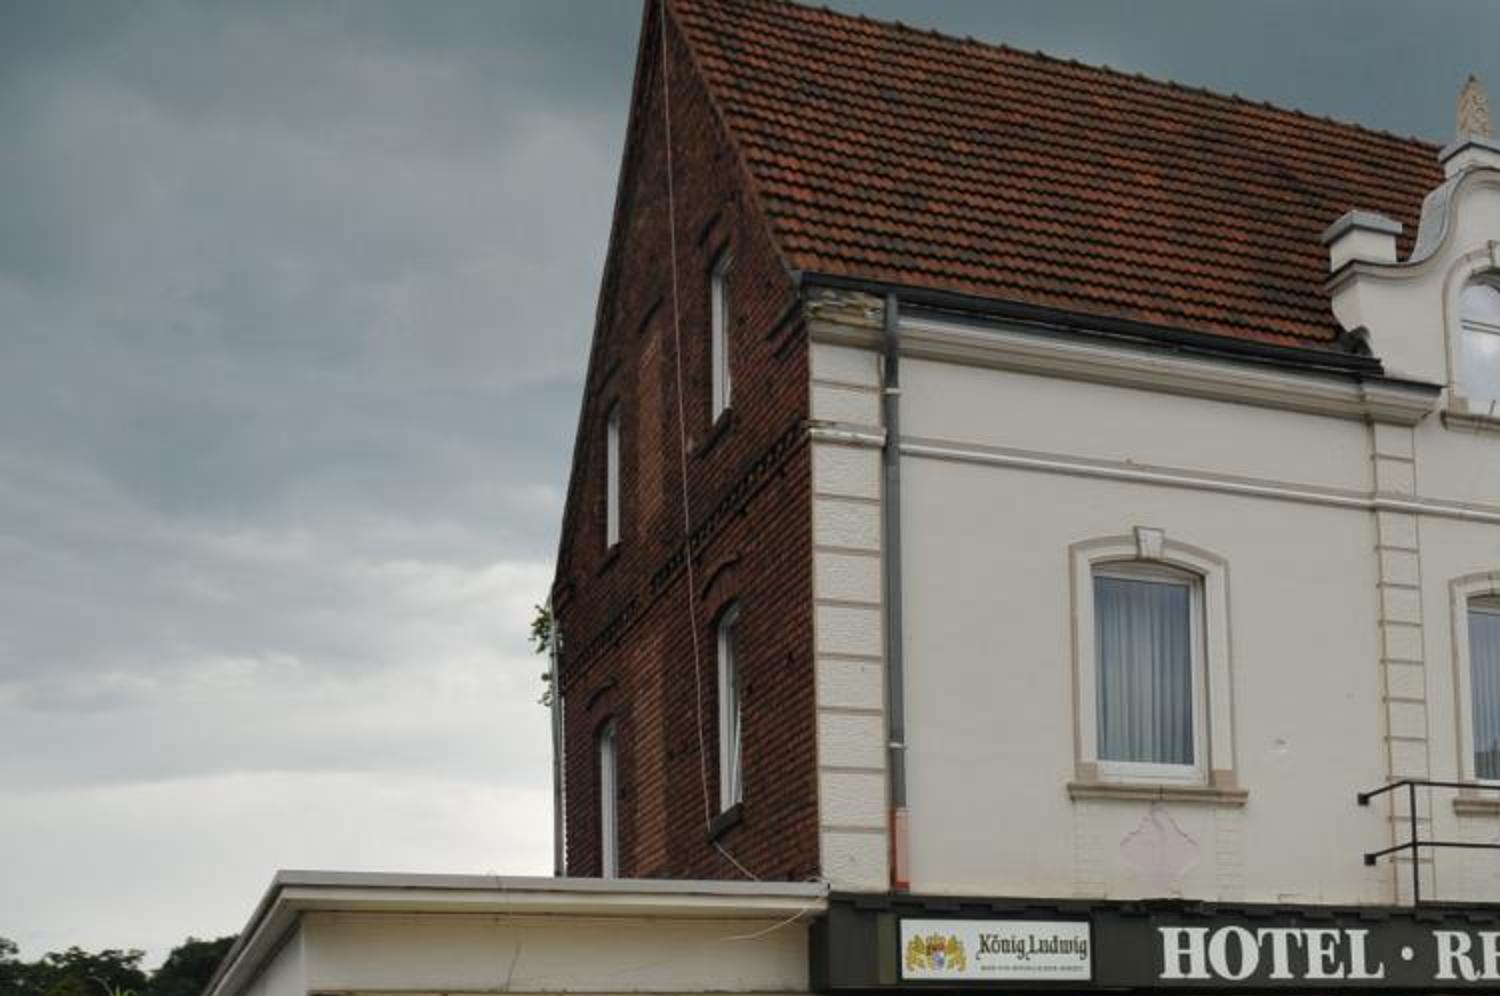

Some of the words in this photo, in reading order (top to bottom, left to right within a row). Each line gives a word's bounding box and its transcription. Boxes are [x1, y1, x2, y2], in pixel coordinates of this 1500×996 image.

[975, 933, 1025, 961] König
[1025, 934, 1088, 961] Ludwig
[1158, 925, 1385, 981] HOTEL
